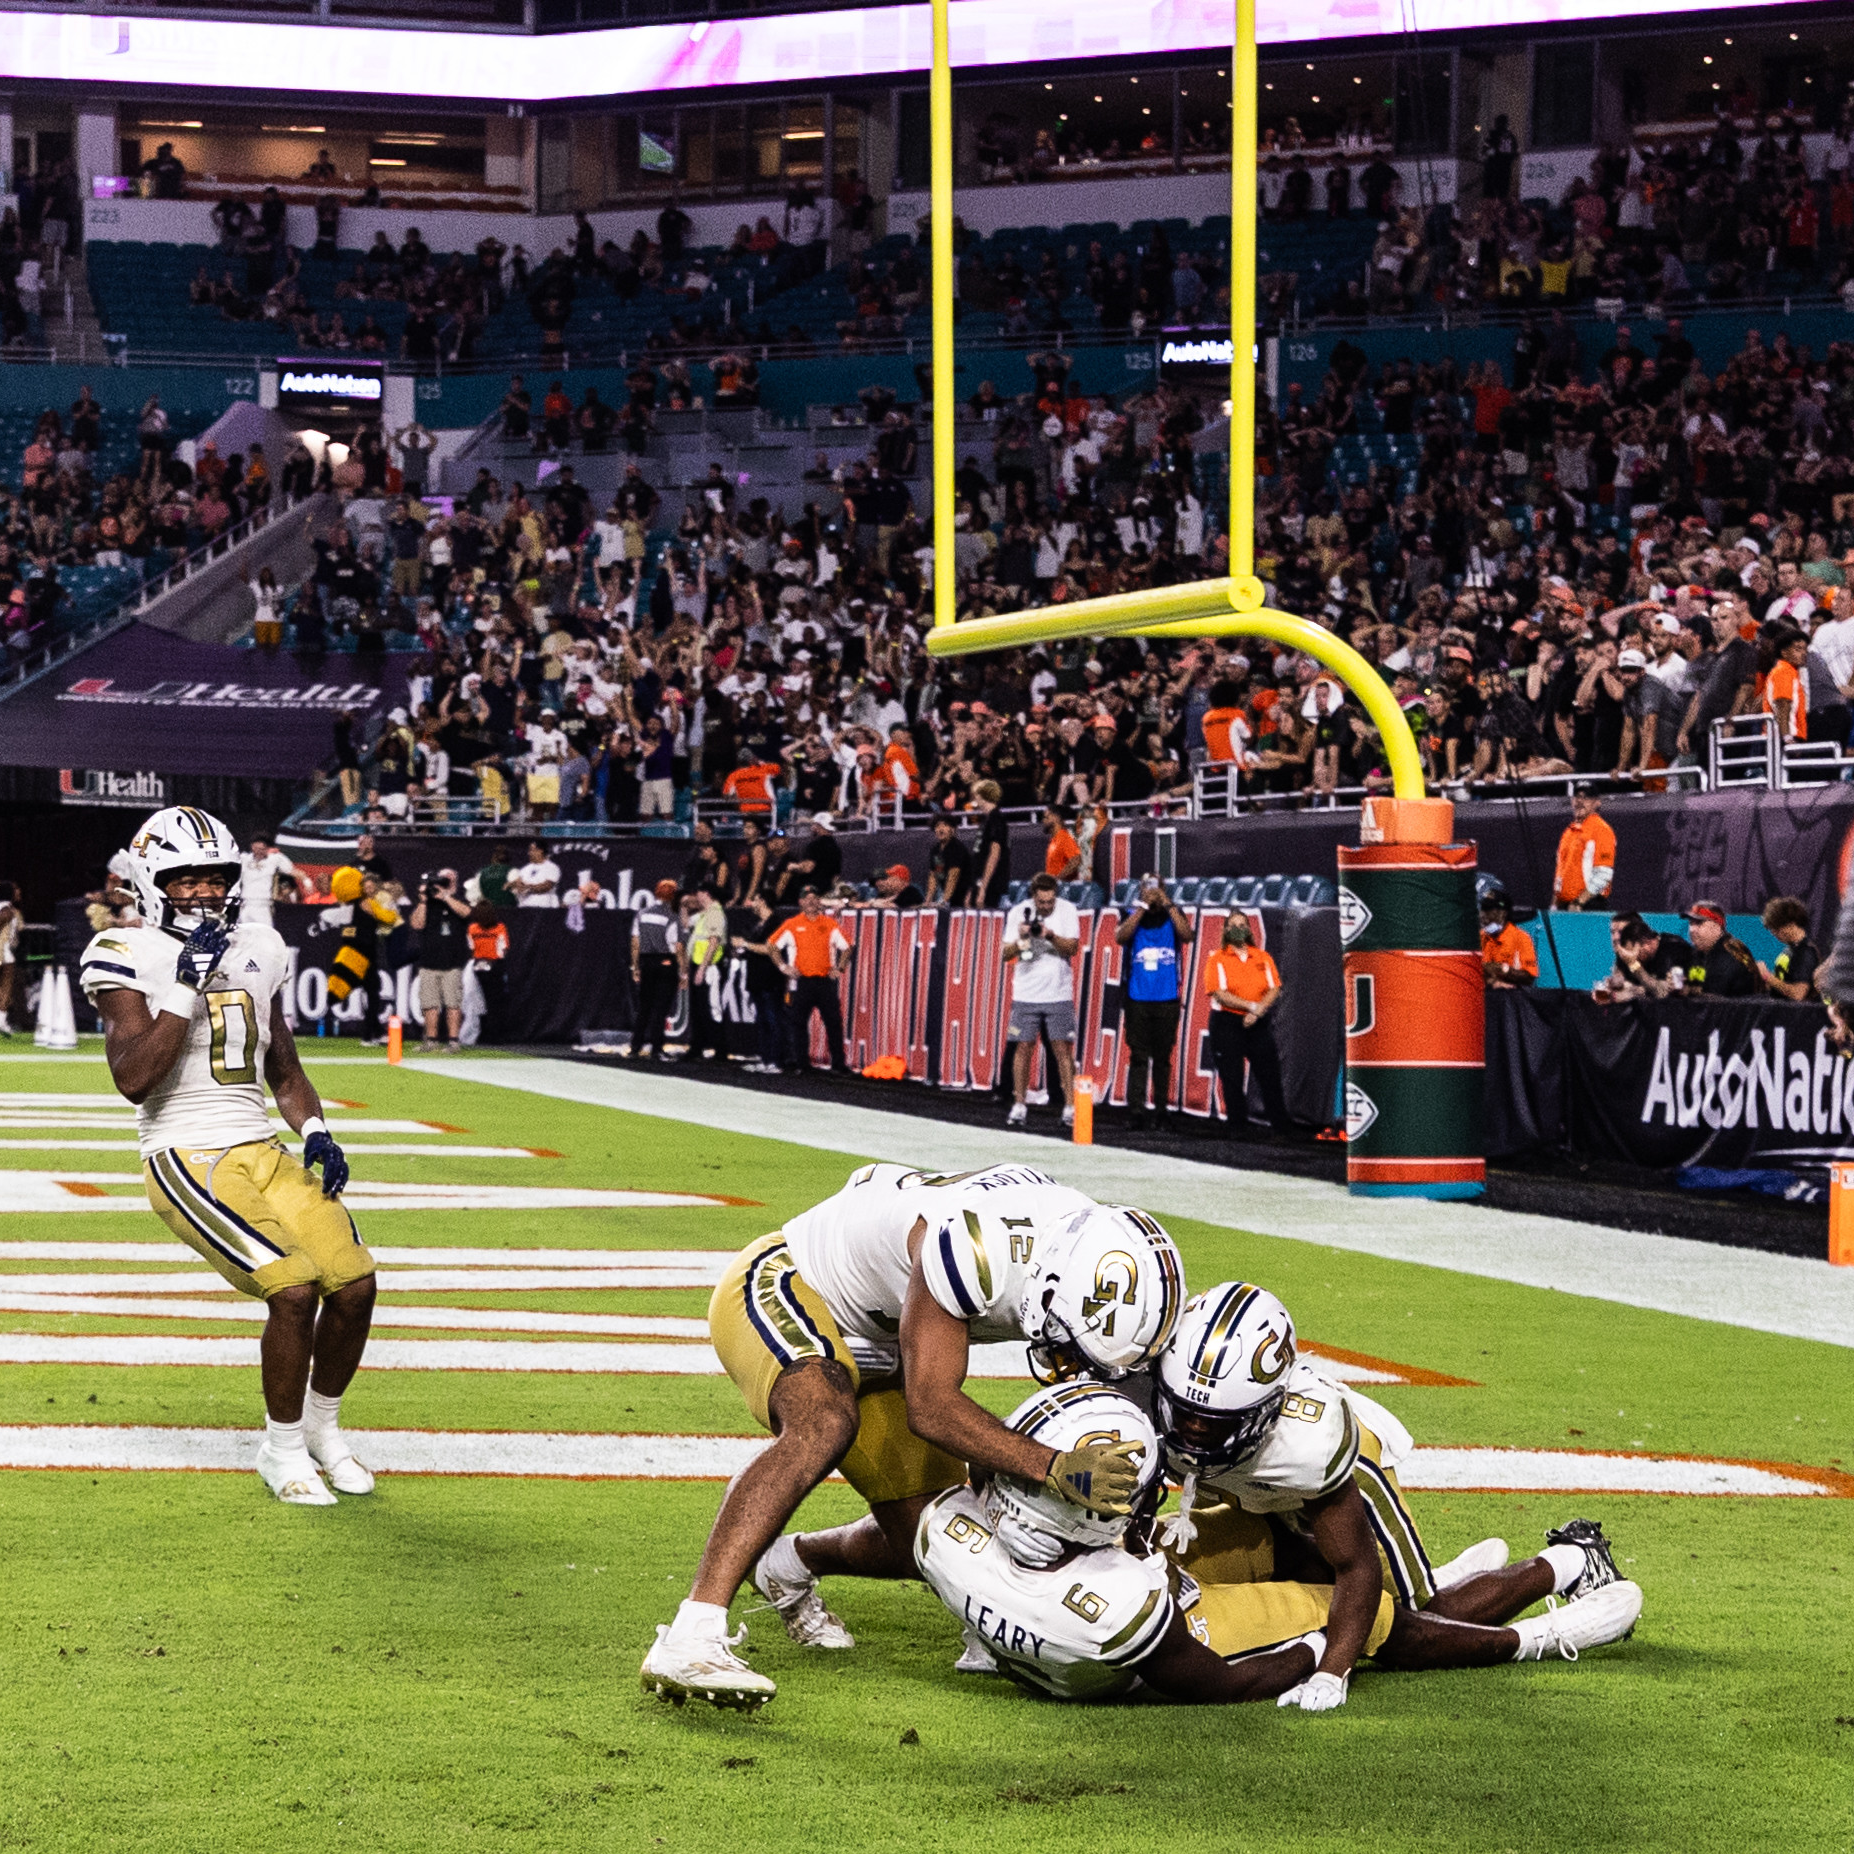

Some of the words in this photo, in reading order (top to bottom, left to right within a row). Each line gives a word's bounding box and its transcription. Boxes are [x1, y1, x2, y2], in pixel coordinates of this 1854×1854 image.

[280, 372, 381, 394] AutoNation
[205, 989, 258, 1085] 0
[1001, 1216, 1034, 1264] 12
[1186, 1386, 1211, 1405] TECH
[1280, 1391, 1326, 1424] 8
[1061, 1583, 1109, 1624] 6
[964, 1595, 1046, 1659] LEARY
